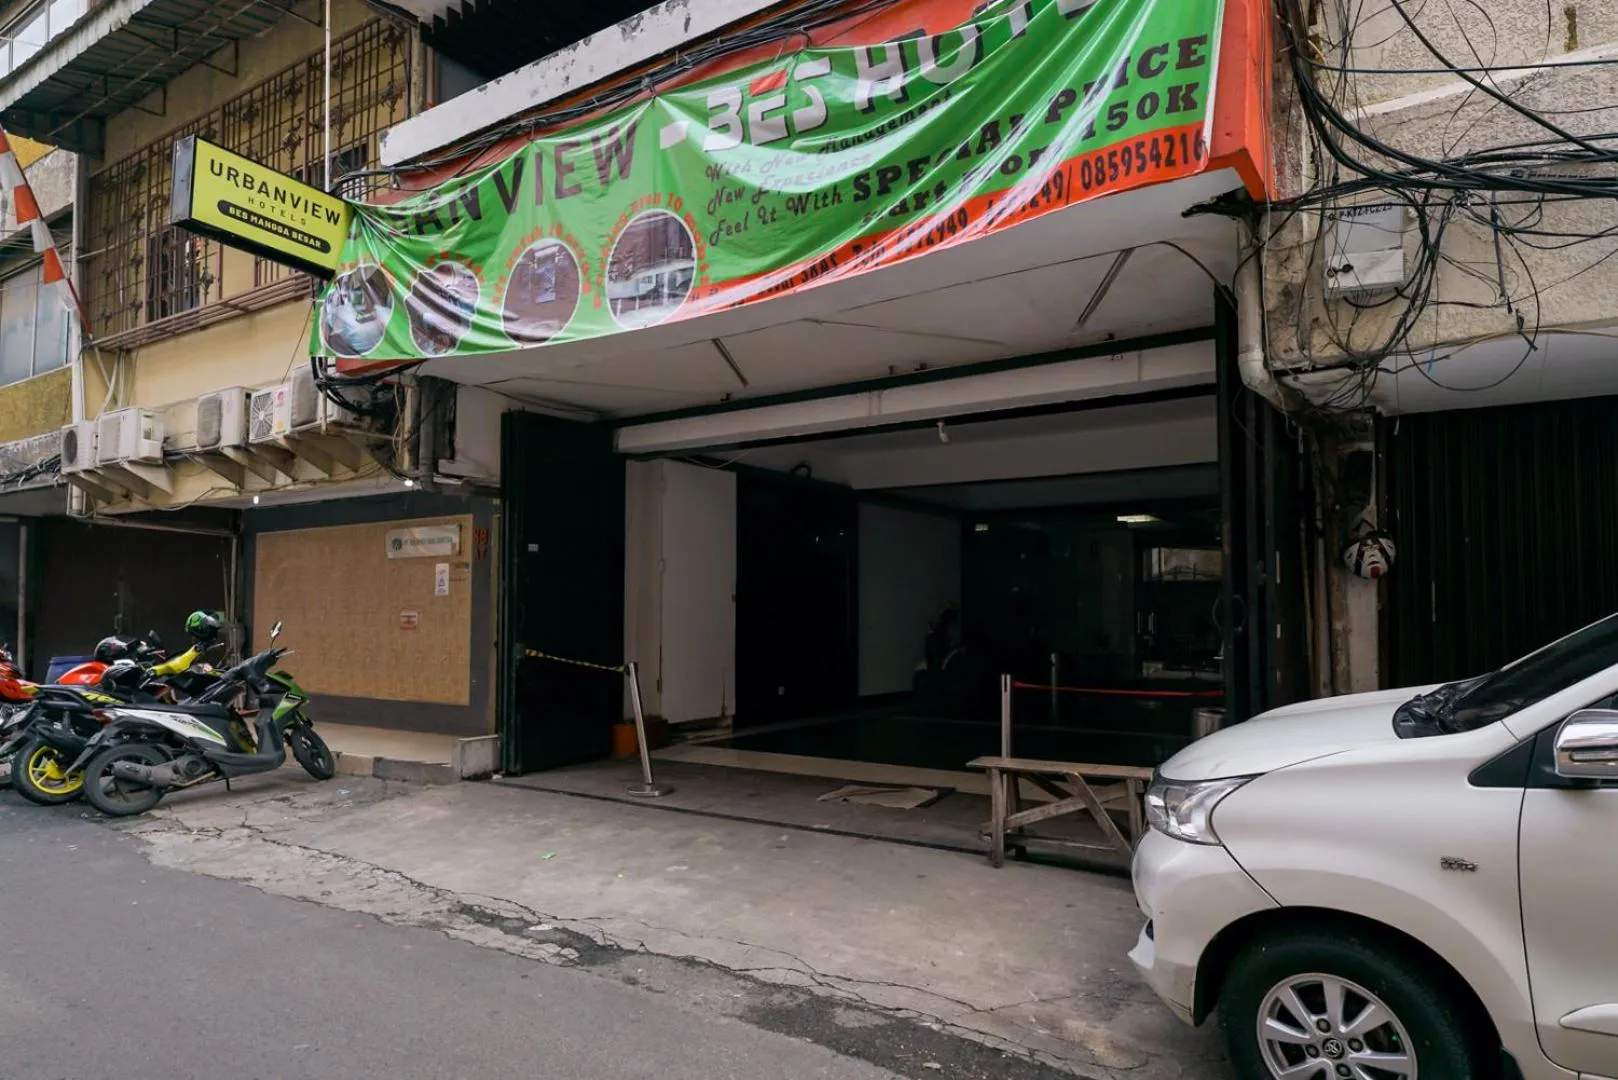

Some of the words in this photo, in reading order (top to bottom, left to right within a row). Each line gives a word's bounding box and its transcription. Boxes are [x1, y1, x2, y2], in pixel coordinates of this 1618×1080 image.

[385, 119, 638, 238] ANVIEW
[703, 60, 832, 152] BES
[854, 0, 1093, 113] HOT
[709, 210, 749, 247] Feel
[785, 185, 843, 217] With
[1044, 34, 1208, 125] PRICE
[209, 158, 341, 226] URBANVIEW
[248, 196, 307, 226] HOTELS
[706, 185, 746, 217] New
[228, 206, 249, 221] BES
[291, 229, 322, 248] BESAR
